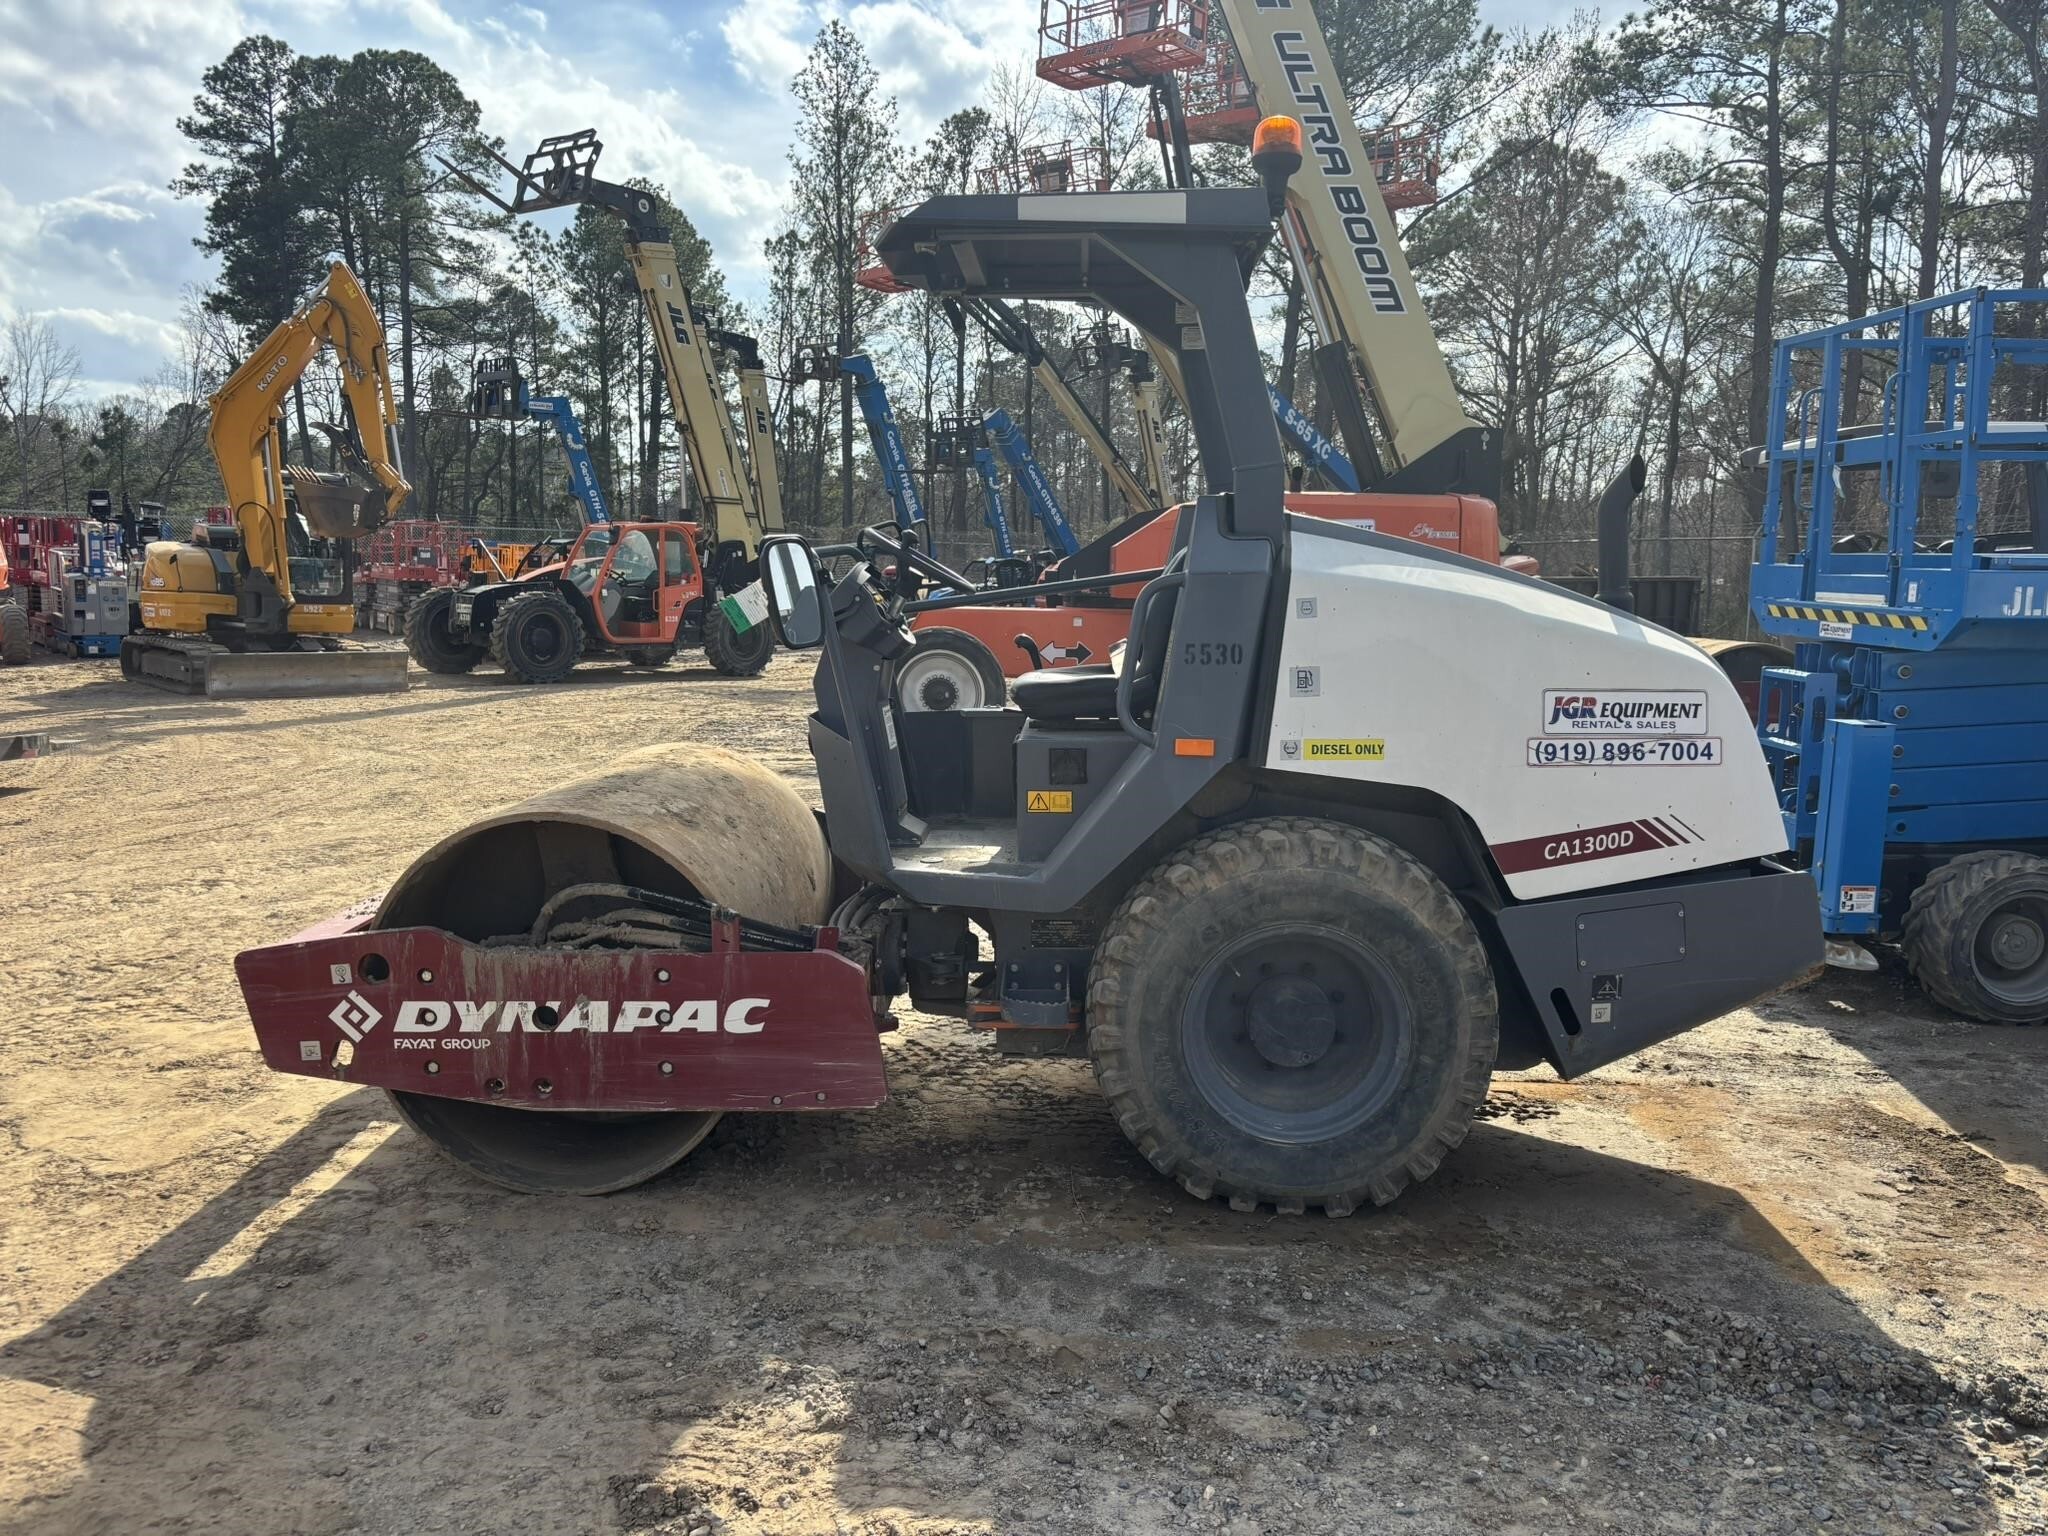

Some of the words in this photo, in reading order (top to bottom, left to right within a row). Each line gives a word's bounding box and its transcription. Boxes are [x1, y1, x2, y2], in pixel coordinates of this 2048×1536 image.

[1272, 31, 1353, 176] ULTRA
[1325, 185, 1407, 314] BOOM
[666, 301, 691, 346] JLG
[257, 355, 288, 391] KATO
[756, 407, 768, 434] JLG
[1152, 417, 1162, 443] JLG
[1285, 408, 1314, 442] S-65
[1312, 434, 1331, 459] XC
[887, 430, 900, 463] Genie
[580, 461, 592, 486] Genie
[1028, 464, 1042, 490] Genie
[2003, 586, 2048, 617] JL
[1184, 643, 1243, 665] 5530
[1548, 696, 1597, 725] JGR
[1600, 702, 1702, 722] EQUIPMENT
[1571, 721, 1619, 729] RENTAL
[1624, 721, 1632, 729] &
[1637, 721, 1676, 729] SALES
[1311, 744, 1352, 755] DIESEL
[1355, 744, 1385, 755] ONLY
[1535, 741, 1596, 763] (919)
[1602, 742, 1714, 761] 896-7004
[1543, 830, 1634, 860] CA1300D
[393, 998, 771, 1034] DYNAPAC
[394, 1038, 437, 1049] FAYAT
[442, 1038, 491, 1049] GROUP
